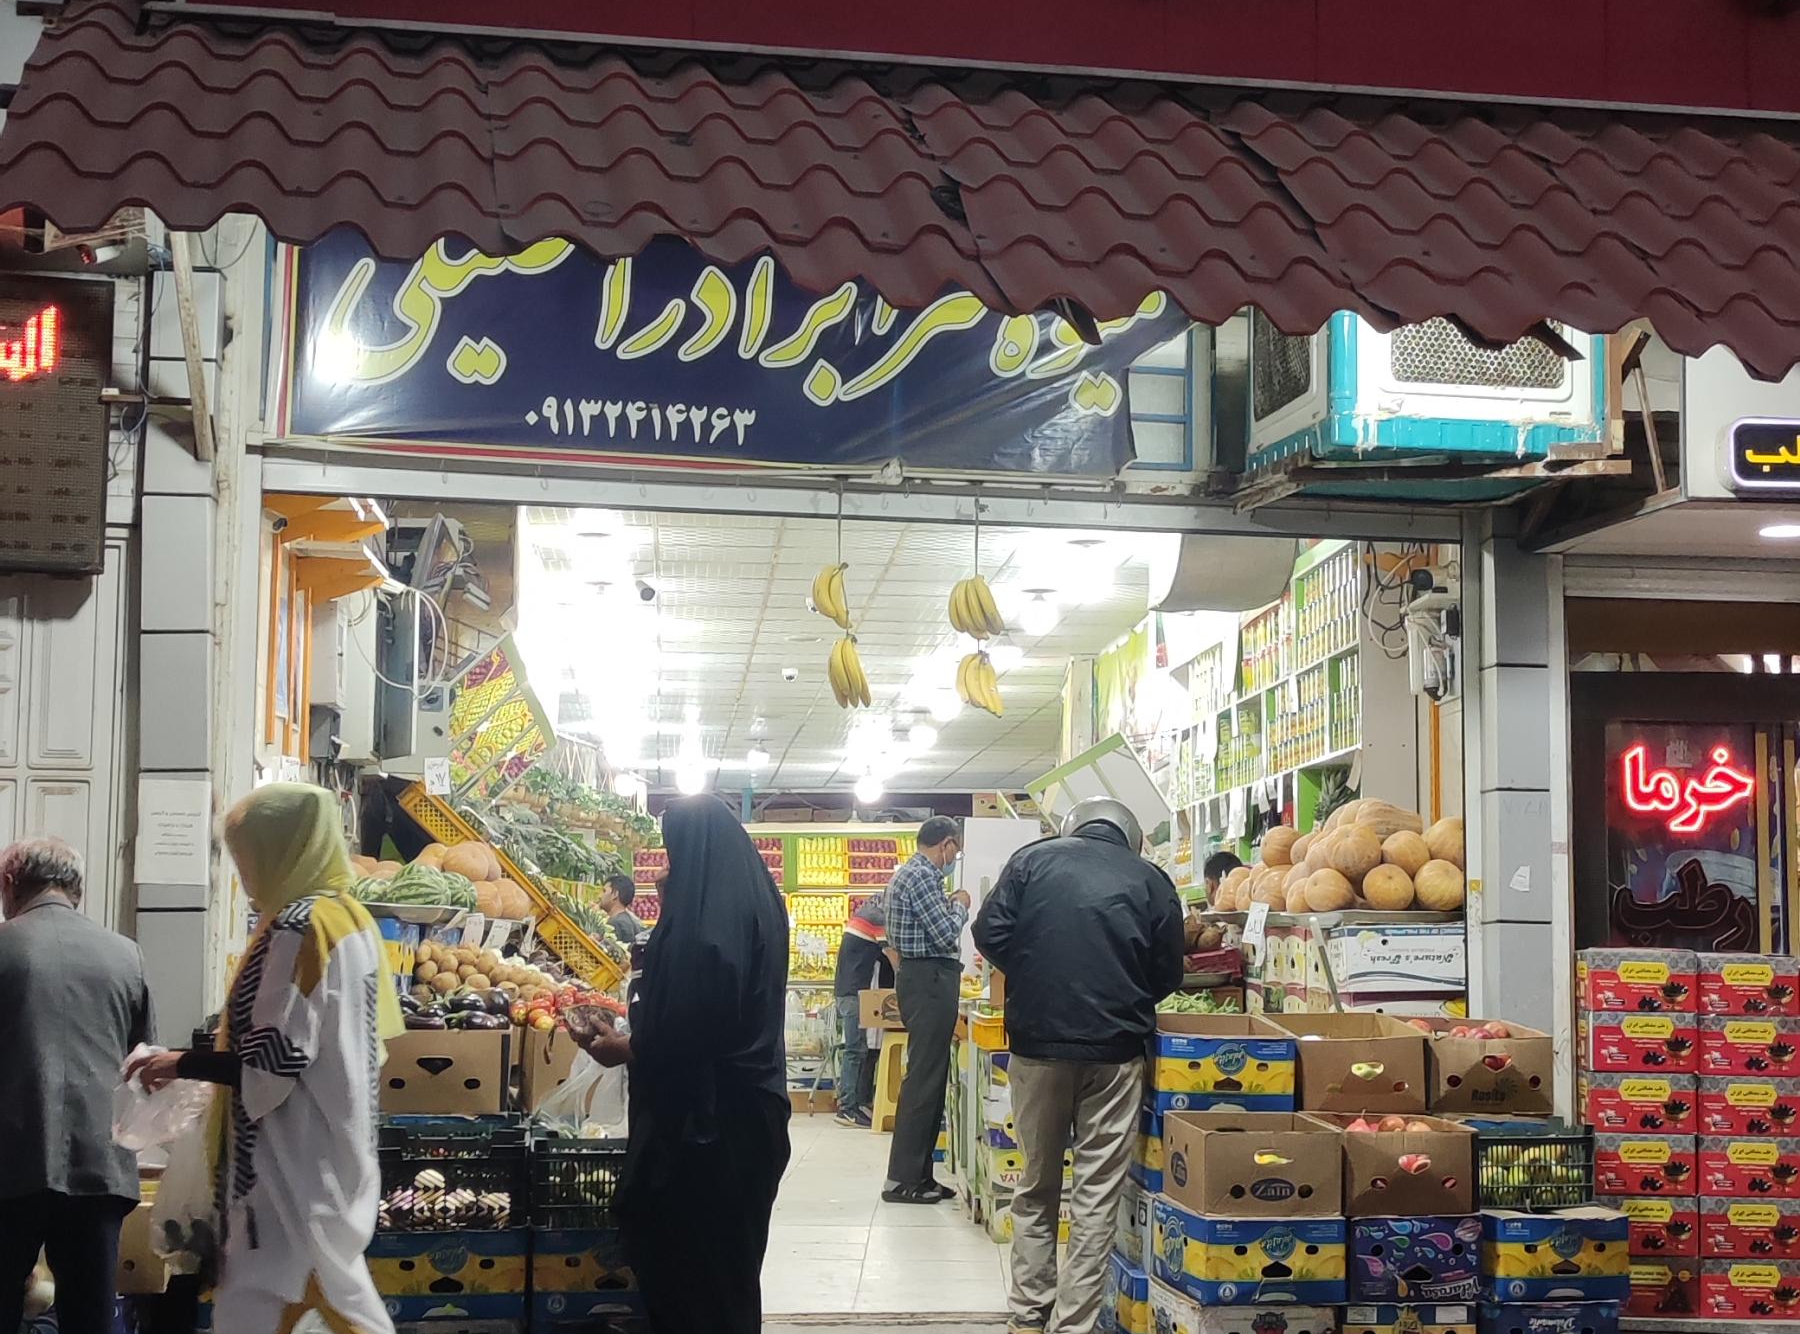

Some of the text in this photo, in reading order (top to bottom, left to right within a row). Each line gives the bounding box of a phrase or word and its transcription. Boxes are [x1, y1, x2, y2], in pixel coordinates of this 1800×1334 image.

[1623, 746, 1754, 832] خرما
[1370, 953, 1454, 964] Nature's Fresh
[1254, 1182, 1292, 1198] Zain
[1422, 1275, 1480, 1300] Velarosa
